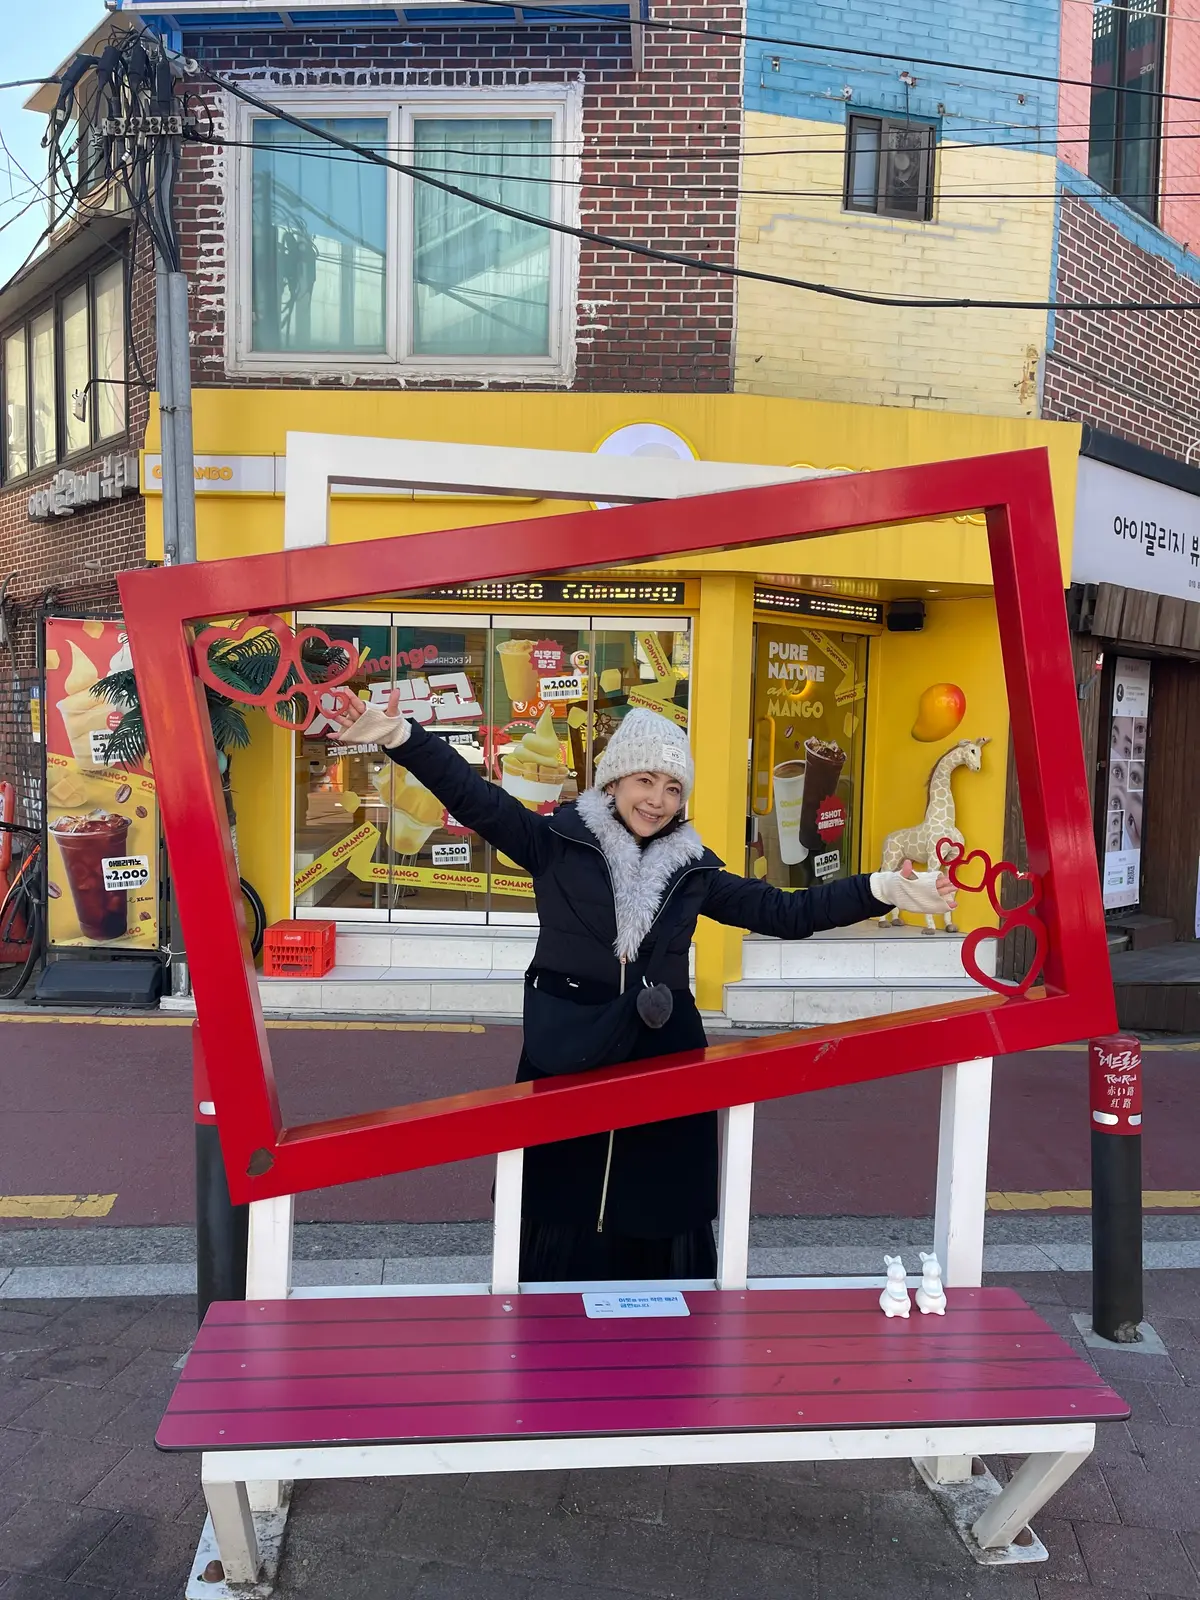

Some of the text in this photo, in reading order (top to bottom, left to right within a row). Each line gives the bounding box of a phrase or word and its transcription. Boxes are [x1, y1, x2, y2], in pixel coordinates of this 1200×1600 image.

[101, 453, 138, 499] 뷰티
[1113, 515, 1186, 557] 아이끌리지
[644, 637, 666, 678] GOMANGO
[768, 641, 809, 661] PURE
[537, 659, 557, 669] 망고
[768, 661, 825, 682] NATURE
[767, 681, 800, 697] and
[768, 698, 824, 718] MANGO
[820, 809, 842, 820] 2SHOT
[331, 826, 371, 859] GOMANGO
[108, 858, 142, 868] 아메리카노
[372, 867, 419, 879] GOMANGO
[433, 873, 480, 884] GOMANGO
[493, 878, 534, 889] GOMANG
[1093, 1046, 1141, 1072] 레드로드
